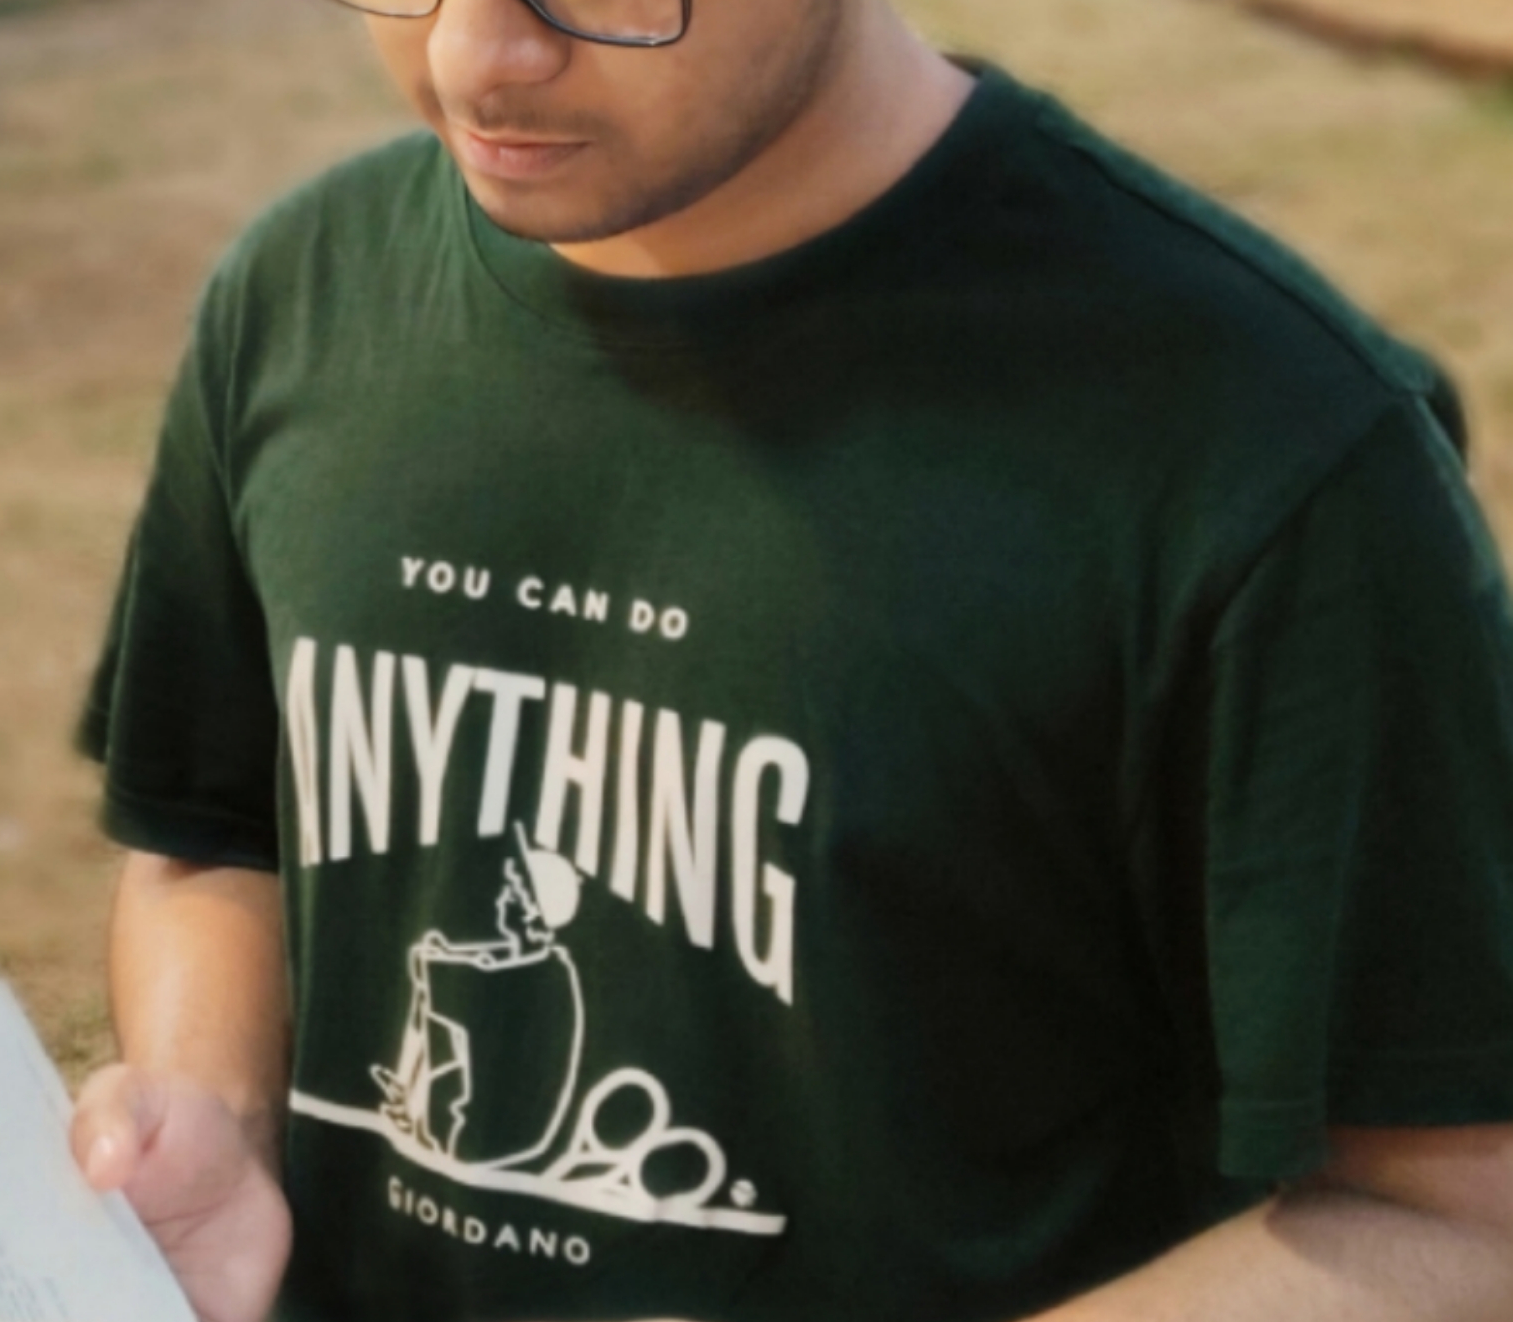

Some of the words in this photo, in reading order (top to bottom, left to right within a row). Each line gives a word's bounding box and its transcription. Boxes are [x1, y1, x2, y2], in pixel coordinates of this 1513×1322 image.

[399, 555, 489, 600] YOU
[516, 576, 610, 623] CAN
[629, 598, 690, 641] DO
[387, 1175, 591, 1267] GIORDANO
